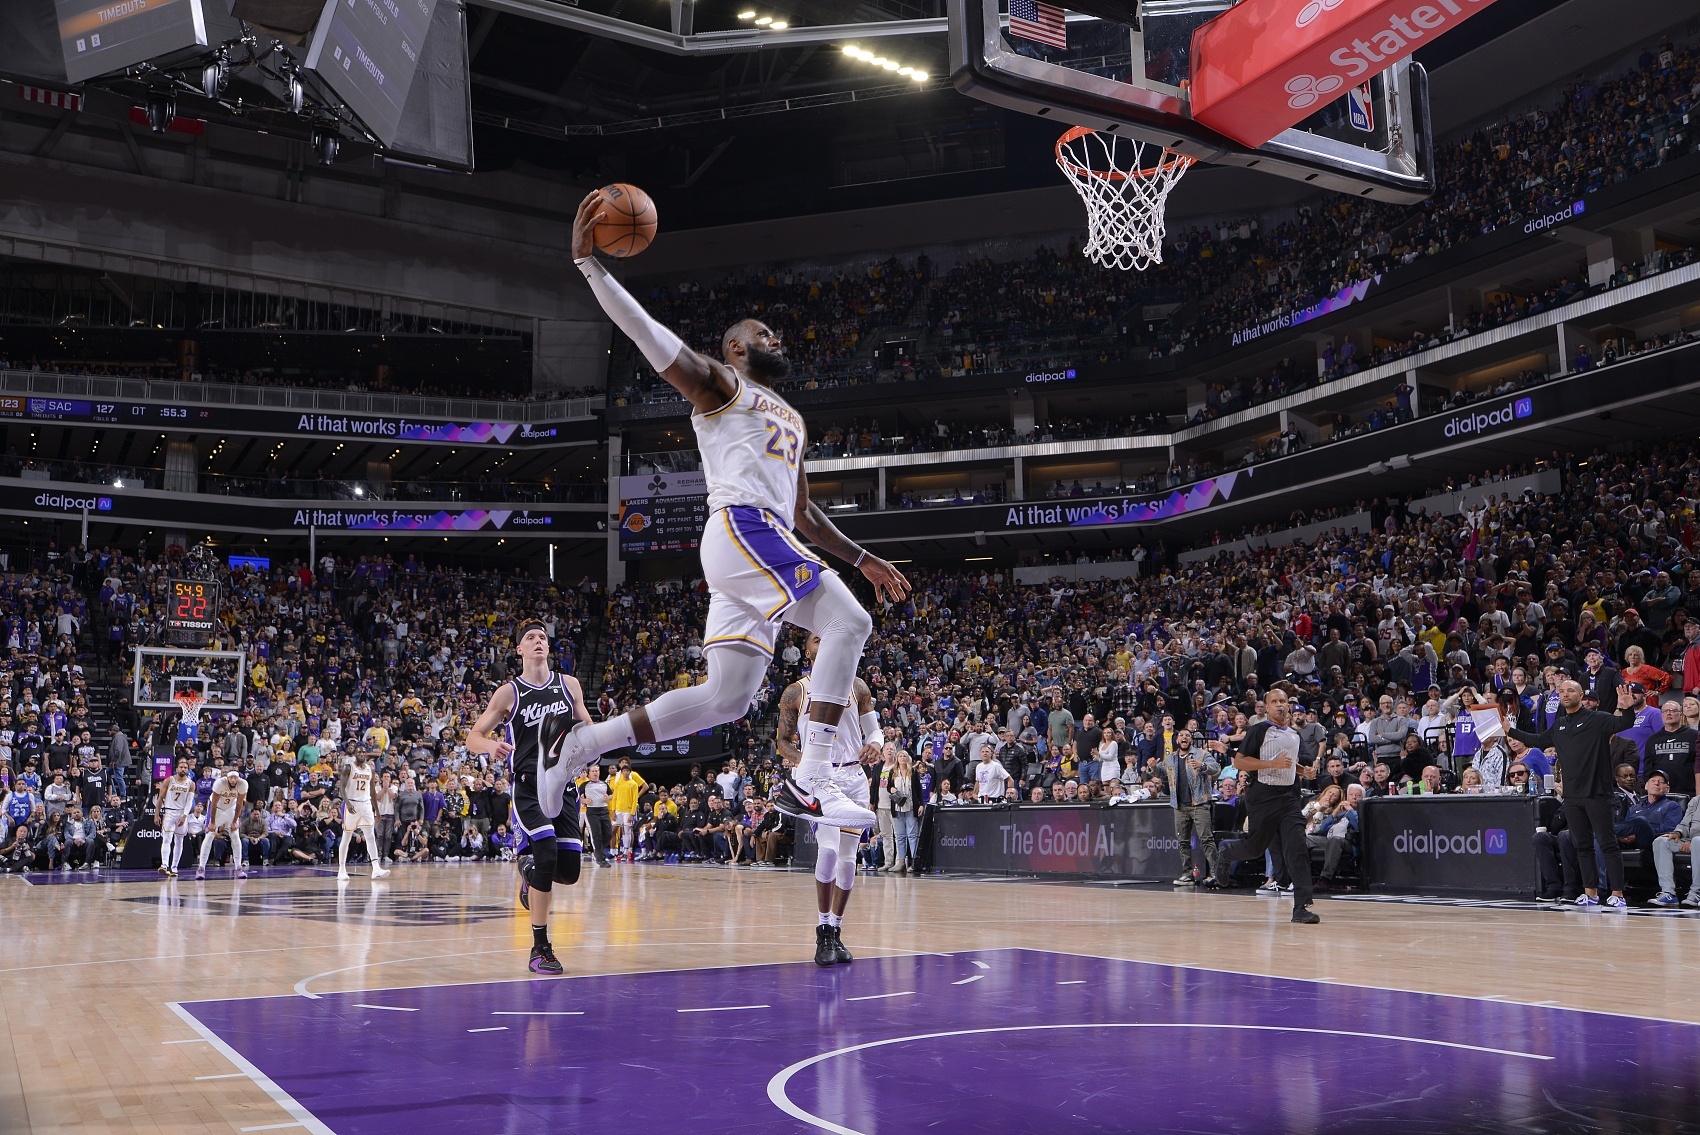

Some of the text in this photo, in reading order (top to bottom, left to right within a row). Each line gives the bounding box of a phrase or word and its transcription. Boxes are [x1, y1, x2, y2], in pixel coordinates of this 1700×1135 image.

[98, 0, 146, 23] TIMEOUTS
[356, 46, 385, 85] TIMEOUTS
[1353, 112, 1366, 126] NBA
[1524, 205, 1572, 233] dialpad
[1243, 324, 1260, 342] that
[1261, 315, 1290, 335] works
[1025, 370, 1065, 383] dialpad
[1, 399, 19, 408] 123
[48, 402, 72, 411] SAC
[96, 404, 114, 414] 127
[132, 406, 146, 415] OT
[160, 408, 187, 417] :55.3
[747, 392, 801, 433] LAKERS
[1444, 402, 1513, 437] dialpad
[298, 415, 314, 430] Ai
[318, 416, 348, 433] that
[351, 418, 396, 435] works
[765, 417, 798, 470] 23
[34, 493, 96, 510] dialpad
[294, 510, 309, 526] Ai
[313, 510, 341, 526] that
[345, 511, 388, 526] works
[513, 516, 543, 526] dialpad
[1006, 507, 1024, 526] Ai
[1028, 505, 1062, 524] that
[1065, 502, 1119, 521] works
[175, 583, 204, 597] 54.9
[177, 596, 207, 618] 22
[182, 621, 213, 629] TISSOT
[520, 700, 568, 723] Kings
[1654, 741, 1690, 750] KINGS
[356, 780, 366, 791] 12
[174, 793, 181, 801] 7
[14, 807, 26, 817] 23
[941, 835, 968, 849] dialpad
[1000, 824, 1114, 856] The Good Ai
[1147, 836, 1180, 852] dialpa
[1393, 829, 1481, 859] dialpad
